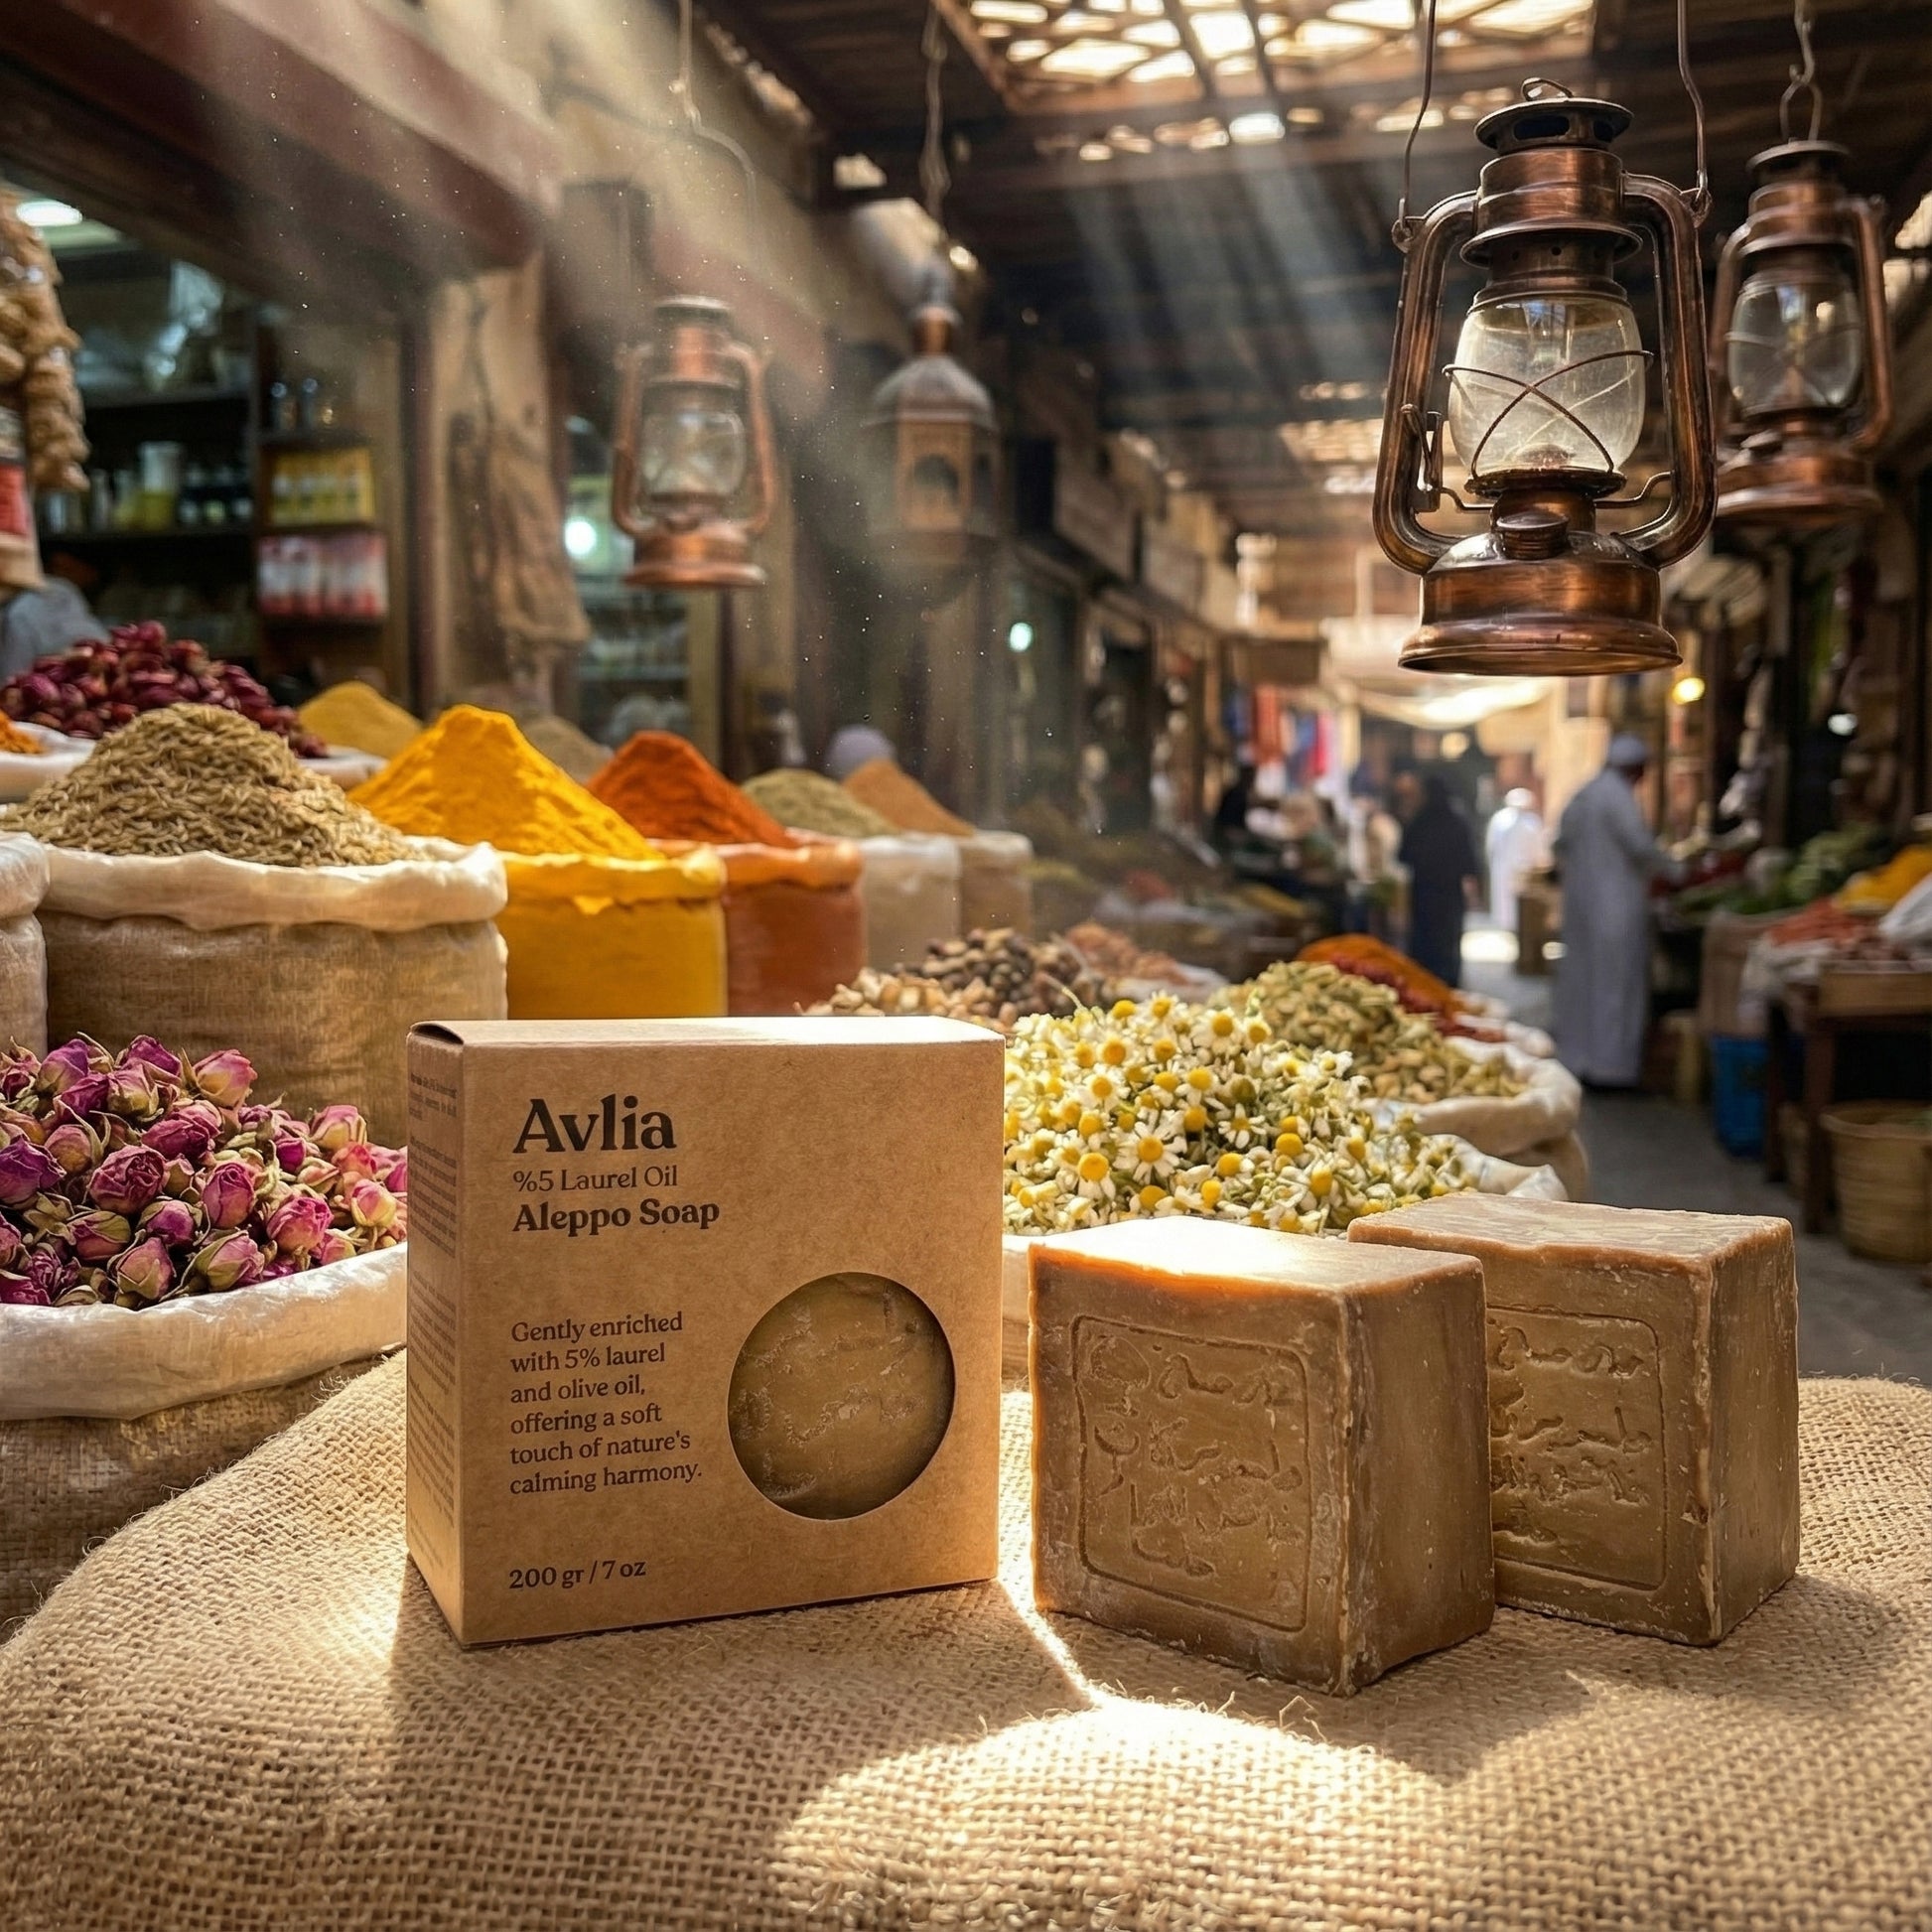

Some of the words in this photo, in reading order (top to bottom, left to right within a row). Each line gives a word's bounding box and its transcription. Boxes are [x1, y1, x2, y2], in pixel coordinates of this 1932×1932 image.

[511, 1093, 678, 1154] Avlia
[512, 1170, 555, 1192] %5
[561, 1166, 637, 1191] Laurel
[643, 1164, 678, 1187] Oil
[511, 1200, 631, 1237] Aleppo
[638, 1197, 720, 1230] Soap
[510, 1318, 586, 1344] Gently
[589, 1311, 683, 1337] enriched
[509, 1351, 560, 1373] with
[564, 1347, 601, 1369] 5%
[606, 1341, 665, 1366] laurel
[510, 1381, 552, 1404] and
[557, 1378, 609, 1400] olive
[614, 1373, 645, 1396] oil,
[510, 1409, 597, 1435] offering
[603, 1412, 616, 1427] a
[621, 1402, 662, 1426] soft
[509, 1441, 573, 1465] touch
[578, 1438, 604, 1458] of
[607, 1430, 691, 1456] nature's
[509, 1469, 597, 1495] calming
[603, 1462, 702, 1486] harmony.
[508, 1567, 557, 1589] 200
[561, 1569, 585, 1589] gr
[602, 1560, 617, 1580] 7
[620, 1561, 646, 1578] oz
